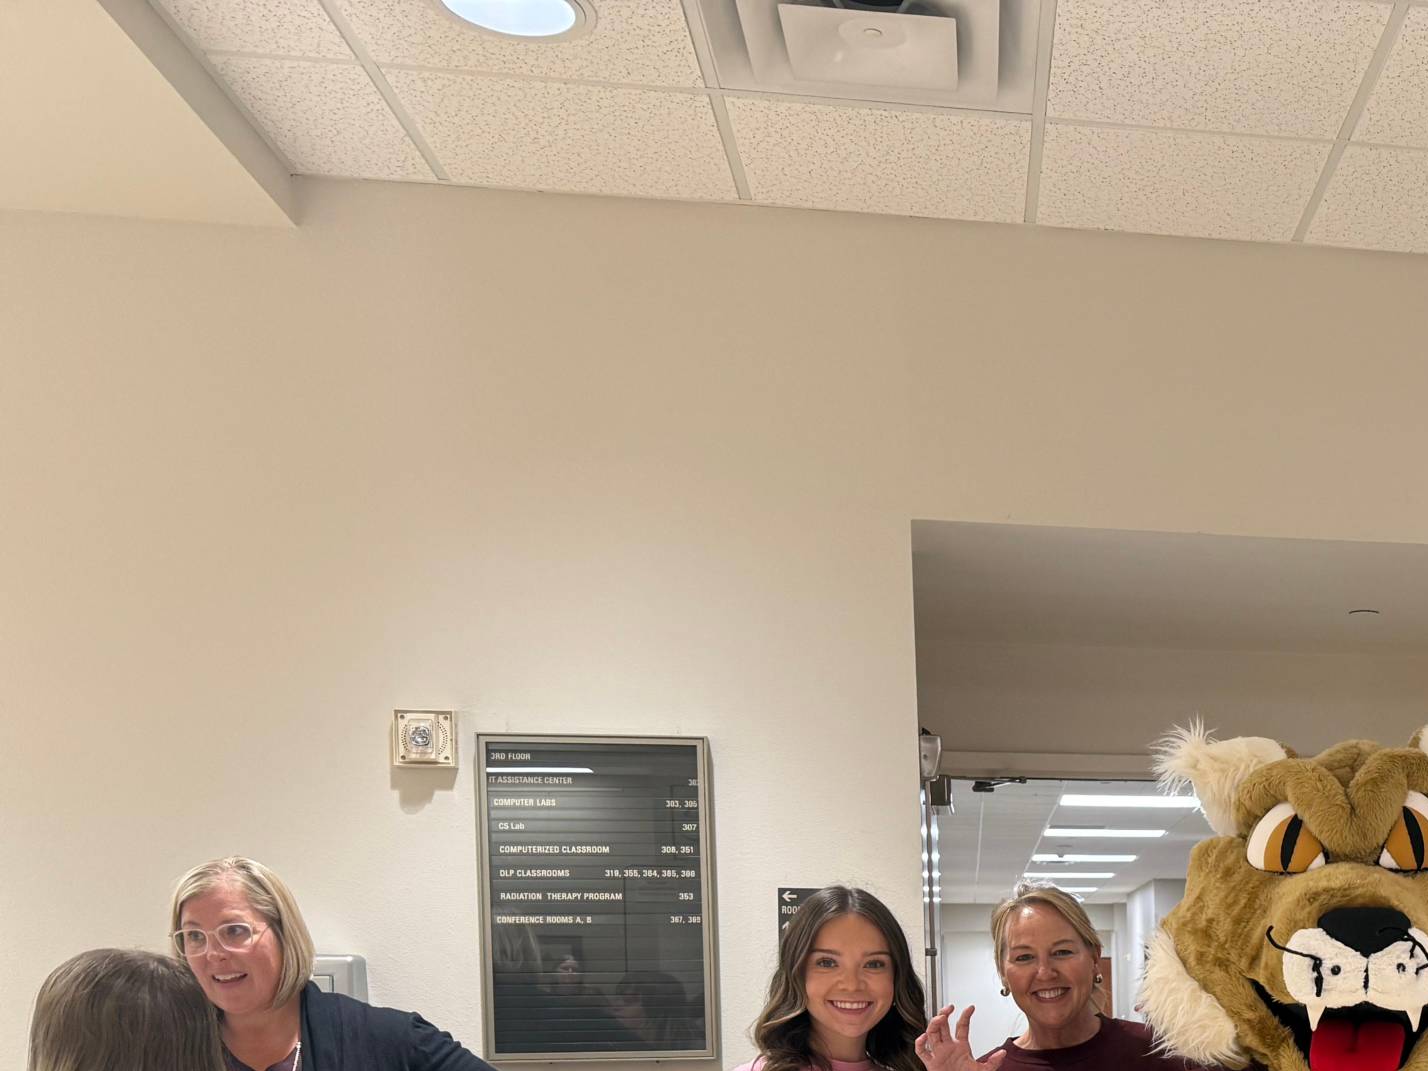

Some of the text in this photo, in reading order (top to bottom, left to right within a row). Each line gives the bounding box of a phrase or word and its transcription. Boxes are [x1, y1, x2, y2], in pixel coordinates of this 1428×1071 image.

[508, 752, 531, 760] FLOOR
[497, 776, 543, 784] ASSISTANCE
[544, 776, 573, 784] CENTER
[493, 798, 534, 807] COMPUTER
[536, 798, 557, 807] LABS
[498, 822, 697, 831] CS Lab 307
[499, 845, 560, 854] COMPUTERIZED
[561, 845, 610, 854] CLASSROOM
[516, 869, 570, 877] CLASSROOMS
[500, 892, 694, 901] RADIATION THERAPY PROGRAM 353
[781, 905, 801, 914] ROO
[497, 916, 544, 924] CONFERENCE
[546, 916, 573, 924] ROOMS
